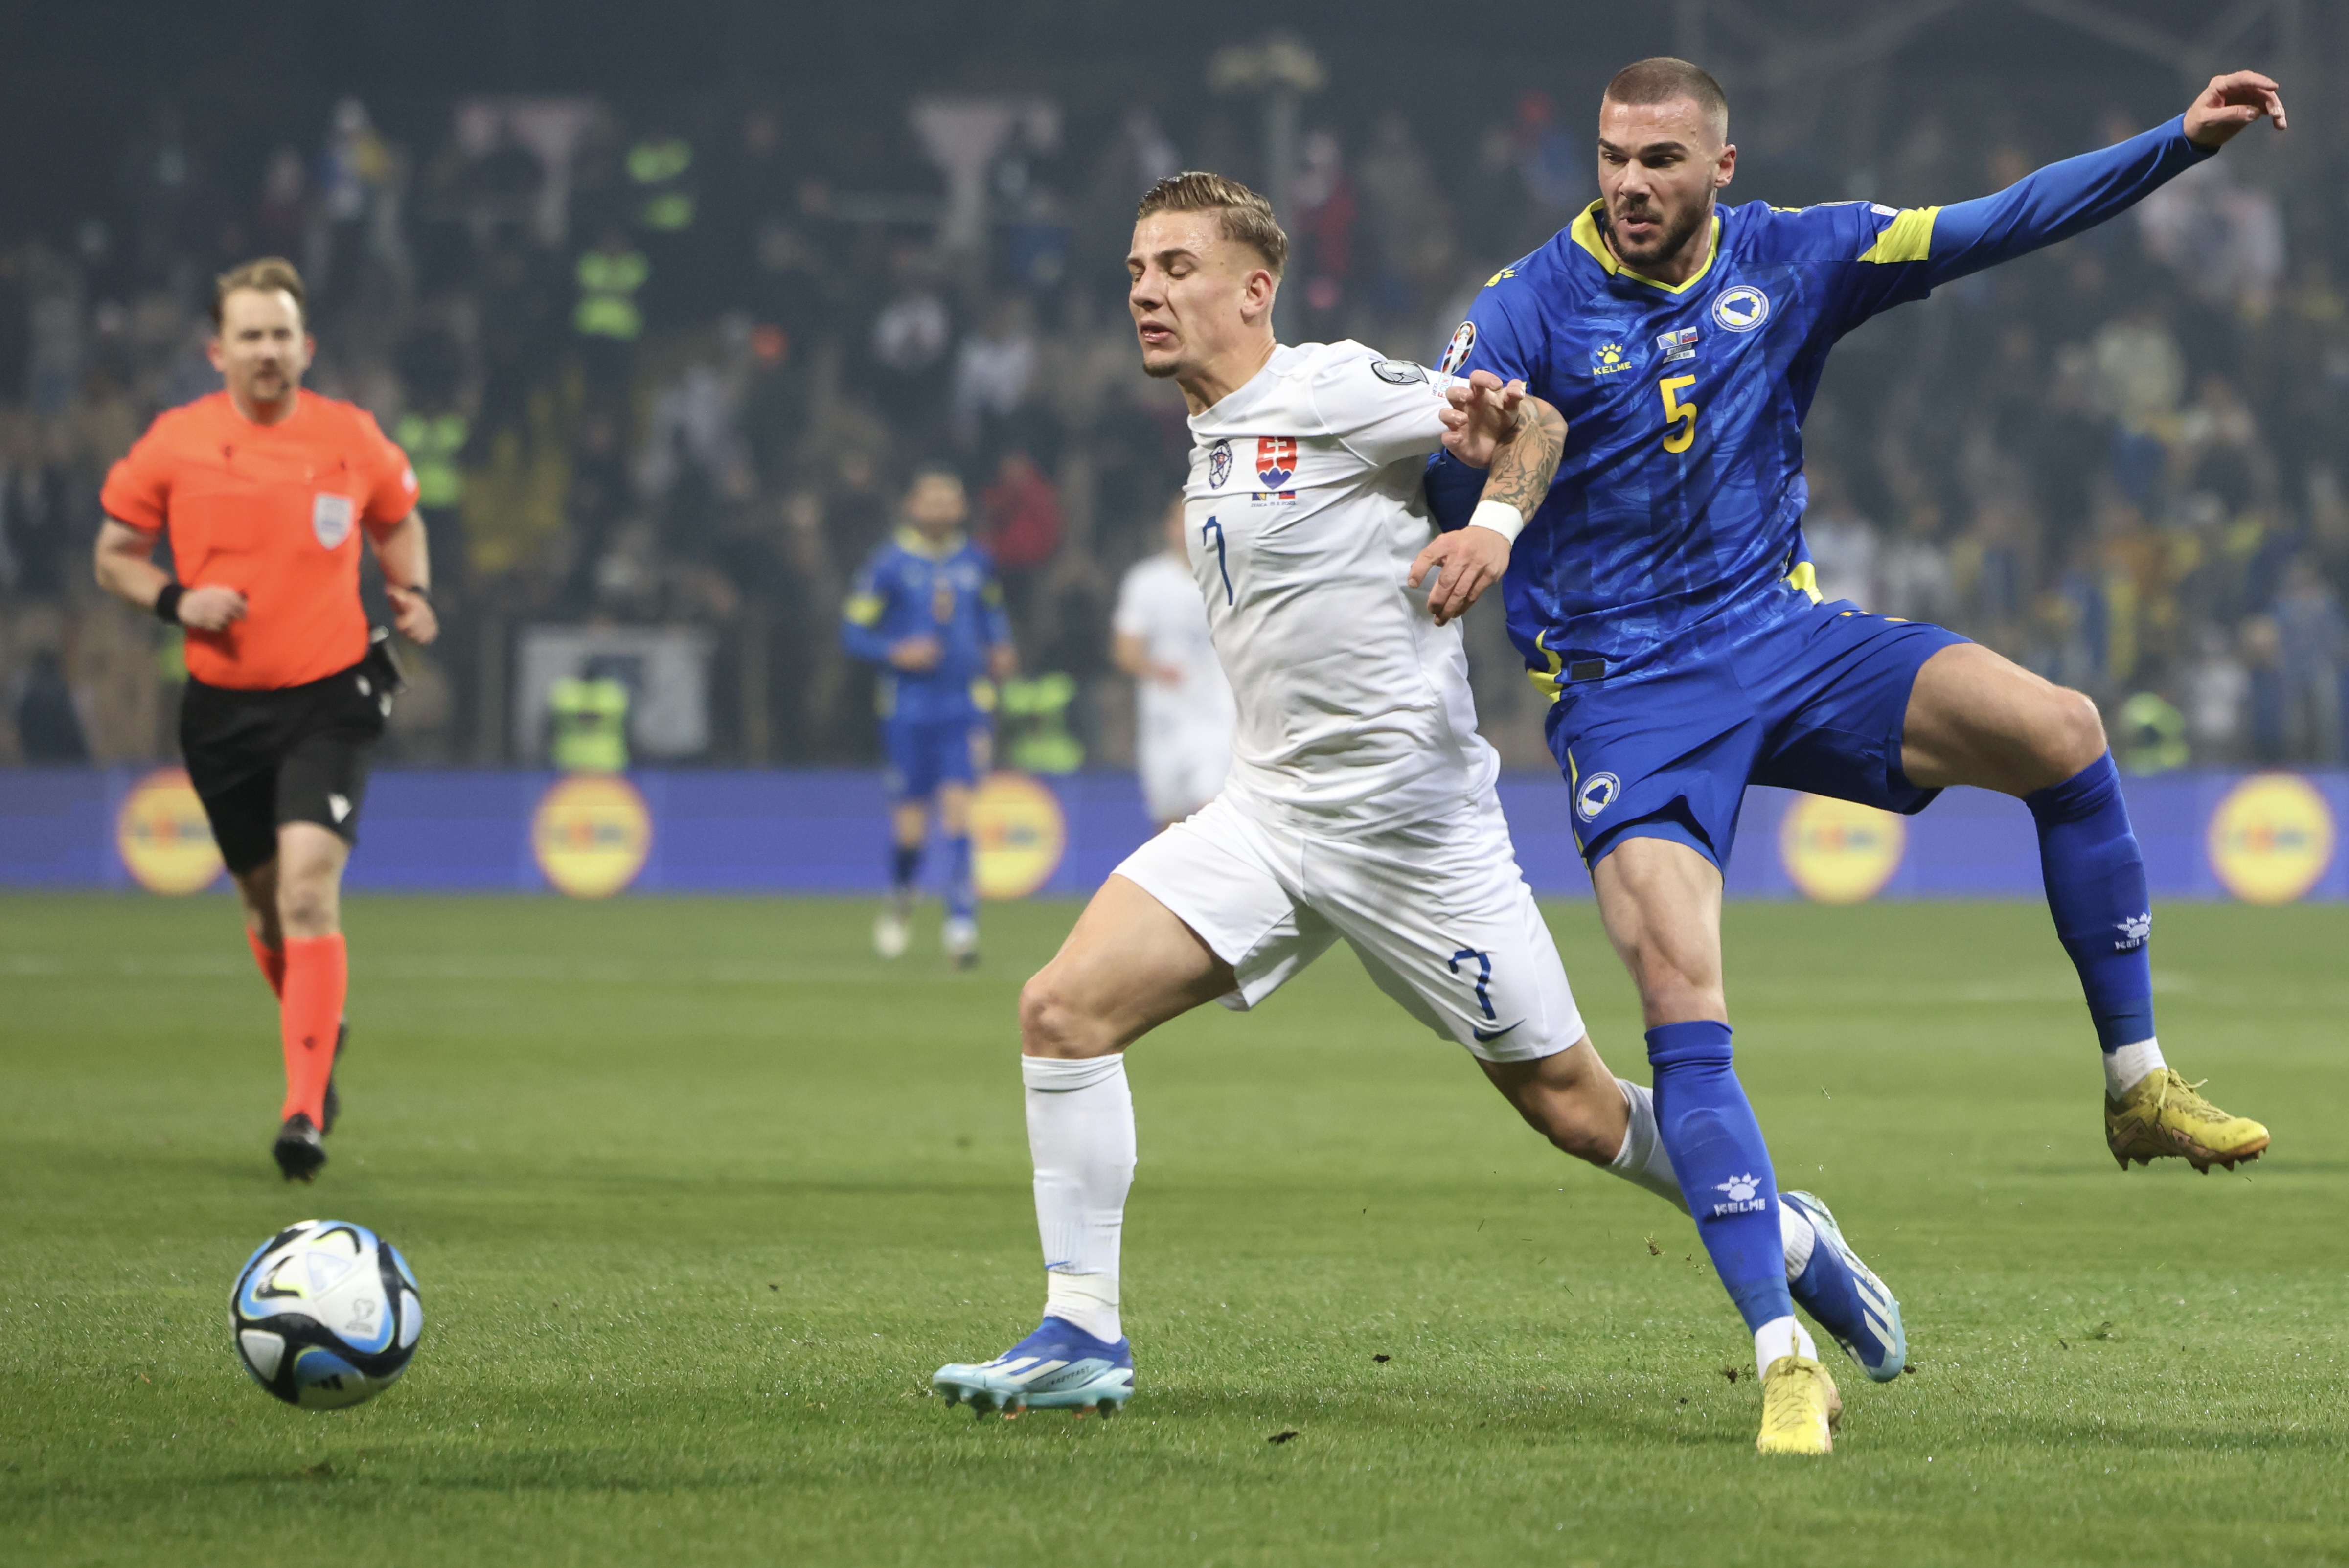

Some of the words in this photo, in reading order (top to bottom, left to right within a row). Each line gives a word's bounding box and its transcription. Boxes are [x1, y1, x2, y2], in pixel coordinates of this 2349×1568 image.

[1593, 361, 1632, 375] KELME
[1660, 374, 1697, 454] 5
[1203, 515, 1233, 606] 7
[1447, 947, 1497, 1020] 7
[1713, 1198, 1766, 1217] KELME
